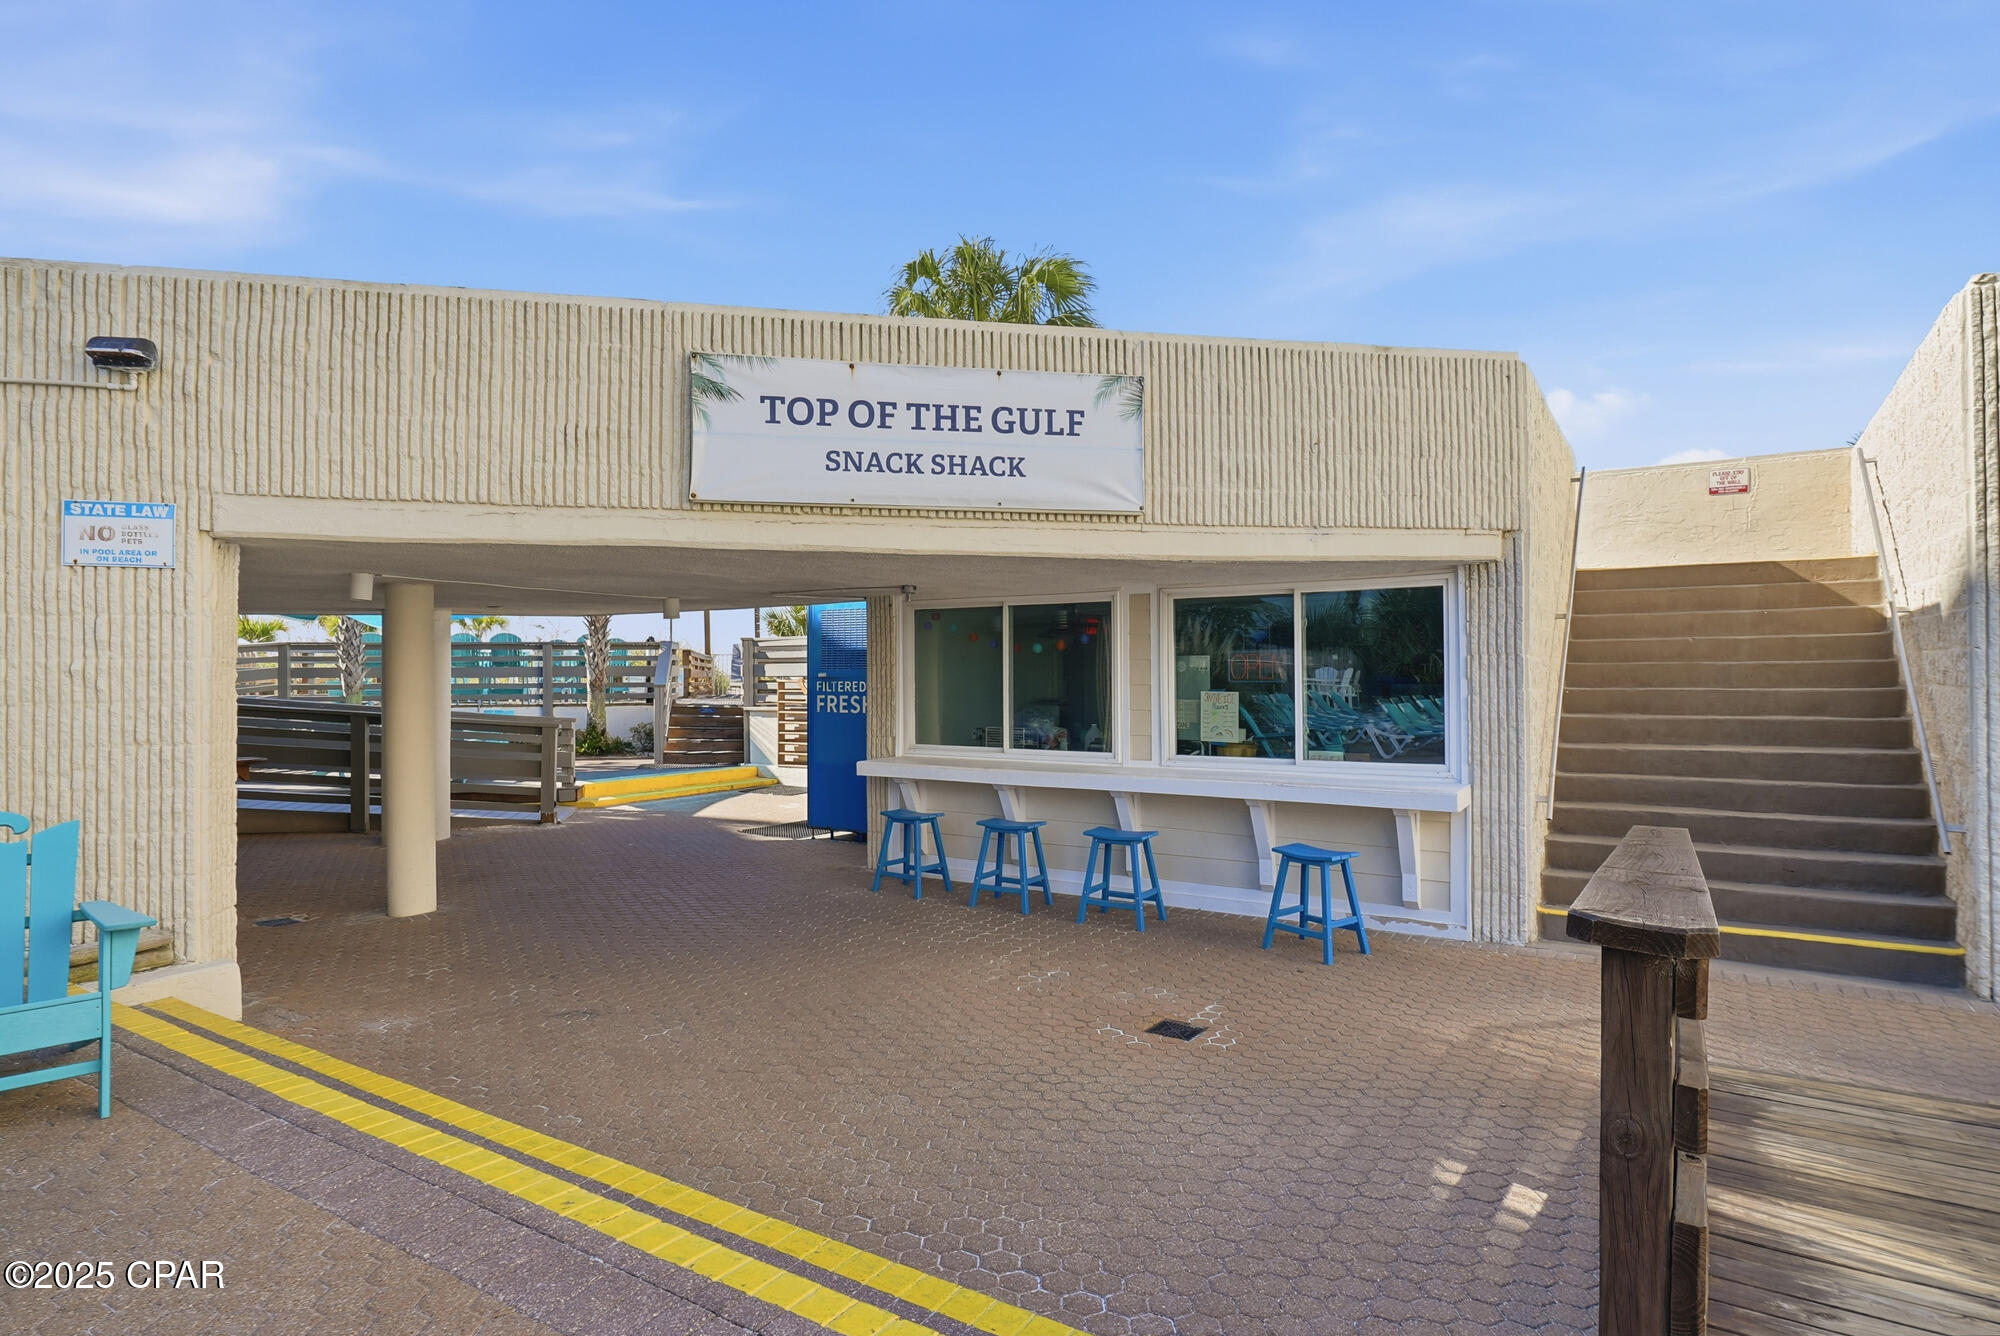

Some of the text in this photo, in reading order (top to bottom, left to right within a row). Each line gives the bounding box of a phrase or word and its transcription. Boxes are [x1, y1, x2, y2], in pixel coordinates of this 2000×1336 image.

[760, 395, 1085, 437] TOP OF THE GULF
[825, 449, 1027, 478] SNACK SHACK
[70, 502, 169, 518] STATE LAW
[79, 525, 116, 542] NO
[92, 548, 116, 556] POOL
[96, 555, 142, 564] ON BEACH
[1231, 653, 1286, 680] OPEN
[816, 681, 866, 692] FILTERED
